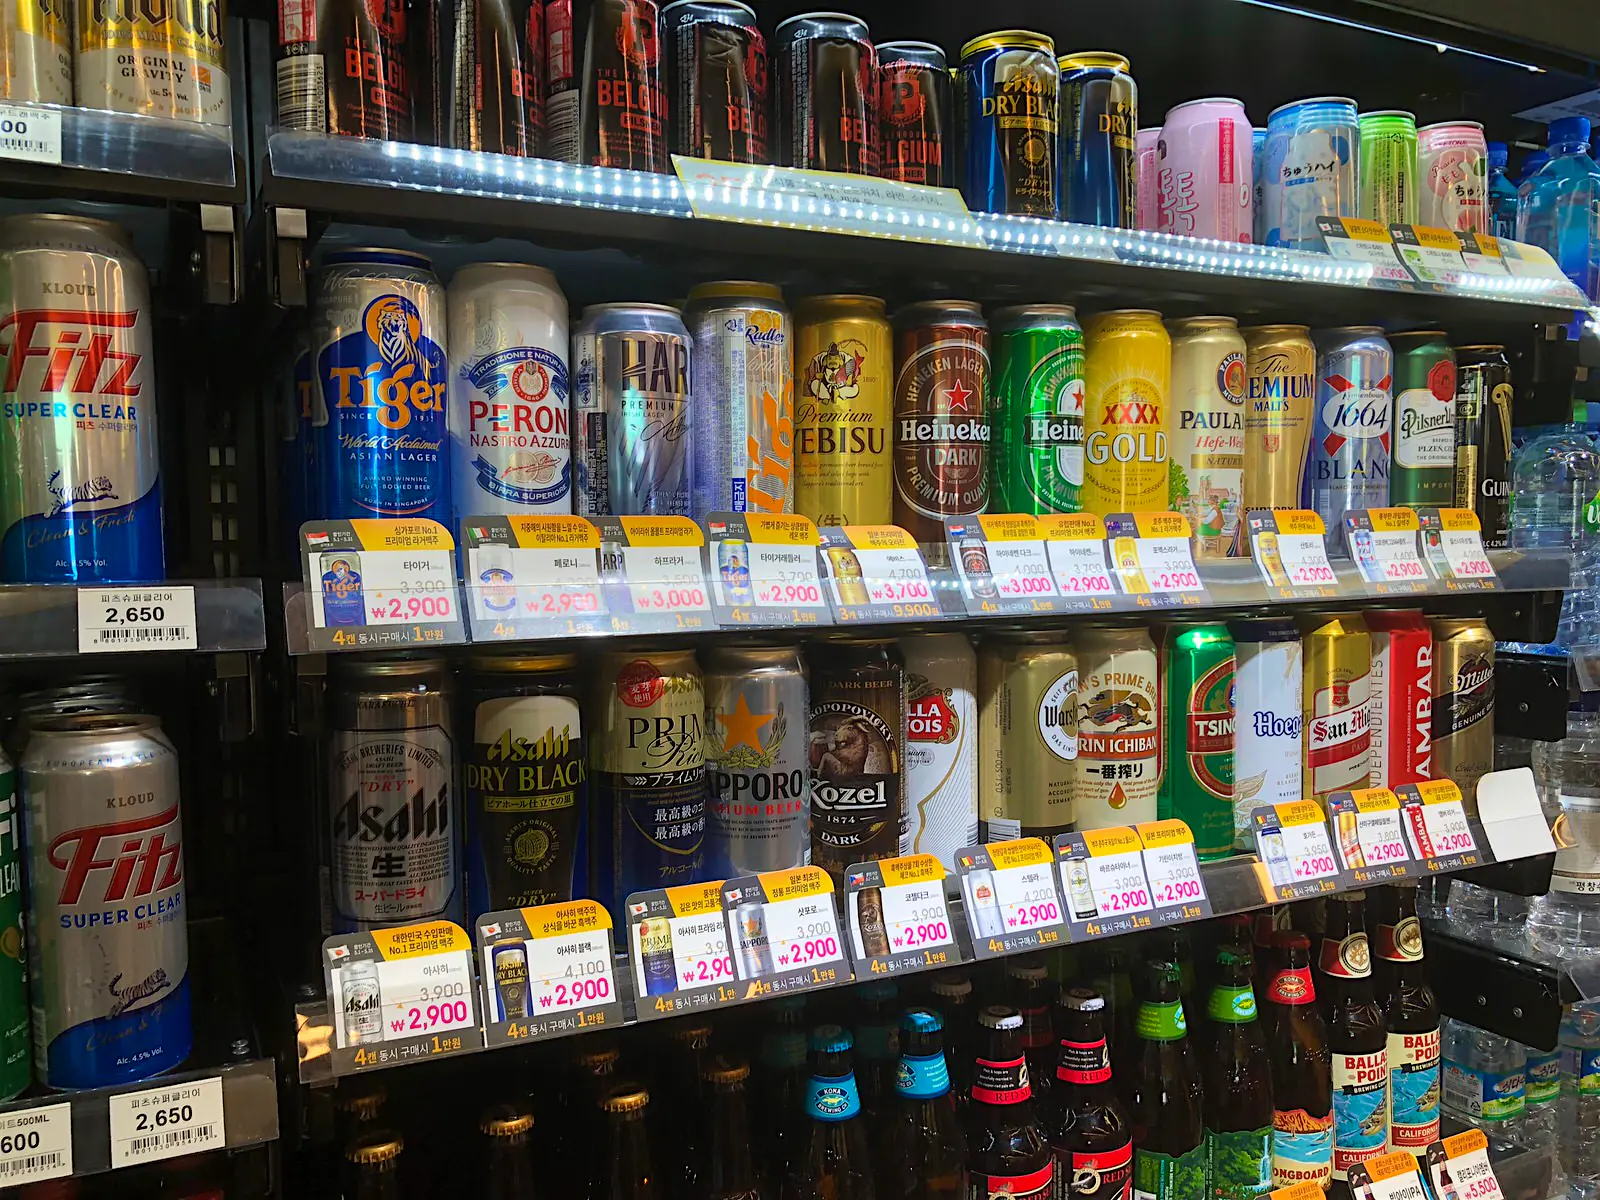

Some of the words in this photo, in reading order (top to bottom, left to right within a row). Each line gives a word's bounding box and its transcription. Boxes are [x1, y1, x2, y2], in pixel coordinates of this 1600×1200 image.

[117, 54, 186, 72] ORIGINAL
[121, 66, 184, 84] GRAVITY
[1282, 160, 1336, 178] ちゅうハイ
[42, 282, 96, 297] KLOUD
[745, 325, 785, 346] Radler
[0, 309, 143, 397] Fitz
[474, 351, 526, 378] TRADIZIONE
[1255, 353, 1290, 375] The
[907, 356, 952, 402] HEINEKEN
[955, 356, 984, 375] LAGER
[329, 361, 446, 430] Tiger
[4, 402, 67, 419] SUPER
[72, 403, 137, 420] CLEAR
[621, 400, 675, 412] PREMIUM
[798, 403, 873, 425] Premium
[1102, 402, 1160, 425] XXXX
[1333, 399, 1389, 430] 1664
[1401, 407, 1446, 439] Pilsner
[350, 452, 393, 461] ASIAN
[401, 453, 438, 462] LAGER
[935, 448, 977, 466] DARK
[1085, 431, 1168, 465] GOLD
[488, 480, 520, 498] BIRRA
[522, 484, 568, 501] SUPERIORE
[906, 466, 959, 506] PREMIUM
[27, 528, 73, 549] Clean
[394, 526, 420, 535] 싱가포르
[421, 525, 438, 535] No.1
[403, 561, 430, 572] 타이거
[554, 558, 578, 568] 페로니
[654, 556, 684, 566] 하프라거
[400, 580, 446, 595] 3,300
[101, 592, 173, 603] 피츠슈퍼클리어
[105, 606, 165, 625] 2,650
[332, 629, 357, 646] 4캔
[358, 633, 379, 644] 동시
[380, 631, 410, 644] 구매시
[413, 626, 445, 642] 1만원
[864, 680, 893, 689] BEER
[1450, 665, 1495, 696] Miller
[1415, 644, 1432, 780] AMBAR
[1452, 709, 1486, 731] GENUINE
[1312, 715, 1348, 743] San
[487, 724, 570, 762] Asahi
[1051, 734, 1062, 748] DAS
[359, 743, 405, 758] BREWERIES
[407, 747, 434, 769] LIMITED
[467, 765, 510, 792] DRY
[518, 758, 586, 792] BLACK
[1086, 763, 1143, 779] 一番搾り
[106, 792, 154, 809] KLOUD
[810, 777, 887, 811] Kozel
[334, 782, 448, 843] Asahi
[765, 801, 801, 816] BEER
[827, 815, 856, 825] 1874
[820, 831, 861, 846] DARK
[1156, 830, 1176, 840] 프리미엄
[1176, 828, 1186, 837] 맥주
[47, 799, 183, 907] Fitz
[372, 853, 406, 879] 生
[1168, 867, 1195, 881] 3,900
[789, 875, 802, 885] 일본
[803, 871, 820, 882] 최초의
[1115, 875, 1142, 891] 3,900
[355, 886, 427, 901] スーパードライ
[785, 883, 809, 895] 프리미엄
[810, 881, 821, 891] 맥주
[1024, 888, 1053, 903] 4,200
[61, 909, 129, 929] SUPER
[135, 892, 182, 919] CLEAR
[556, 909, 576, 919] 아사히
[576, 905, 597, 916] 맥주의
[797, 905, 818, 917] 삿포로
[912, 906, 944, 922] 3,900
[392, 932, 423, 943] 대한민국
[423, 926, 453, 938] 수입판매
[797, 921, 832, 938] 3,900
[389, 944, 407, 955] No.1
[409, 940, 438, 952] 프리미엄
[439, 937, 455, 947] 맥주
[556, 944, 577, 956] 아사히
[578, 942, 592, 953] 블랙
[423, 964, 449, 976] 아사히
[565, 960, 605, 979] 4,100
[788, 974, 811, 987] 구매시
[812, 967, 836, 983] 1만원
[1283, 976, 1299, 984] KONA
[420, 982, 464, 1003] 3,900
[655, 997, 673, 1012] 4캔
[692, 992, 717, 1006] 구매시
[507, 1022, 528, 1039] 4캔
[530, 1023, 548, 1035] 동시
[549, 1017, 575, 1031] 구매시
[577, 1011, 605, 1027] 1만원
[116, 1057, 131, 1066] Alc.
[132, 1051, 151, 1062] 4.5%
[151, 1046, 163, 1057] Vol.
[354, 1047, 377, 1065] 4캔
[379, 1050, 399, 1062] 동시
[400, 1044, 429, 1057] 구매시
[431, 1036, 461, 1053] 1만원
[1411, 1062, 1432, 1072] BREWING
[1081, 1072, 1097, 1082] RED
[823, 1088, 842, 1096] KONA
[995, 1092, 1011, 1102] RED
[1353, 1084, 1378, 1094] BREWING
[131, 1088, 201, 1109] 피츠슈퍼클리어
[135, 1104, 194, 1131] 2,650
